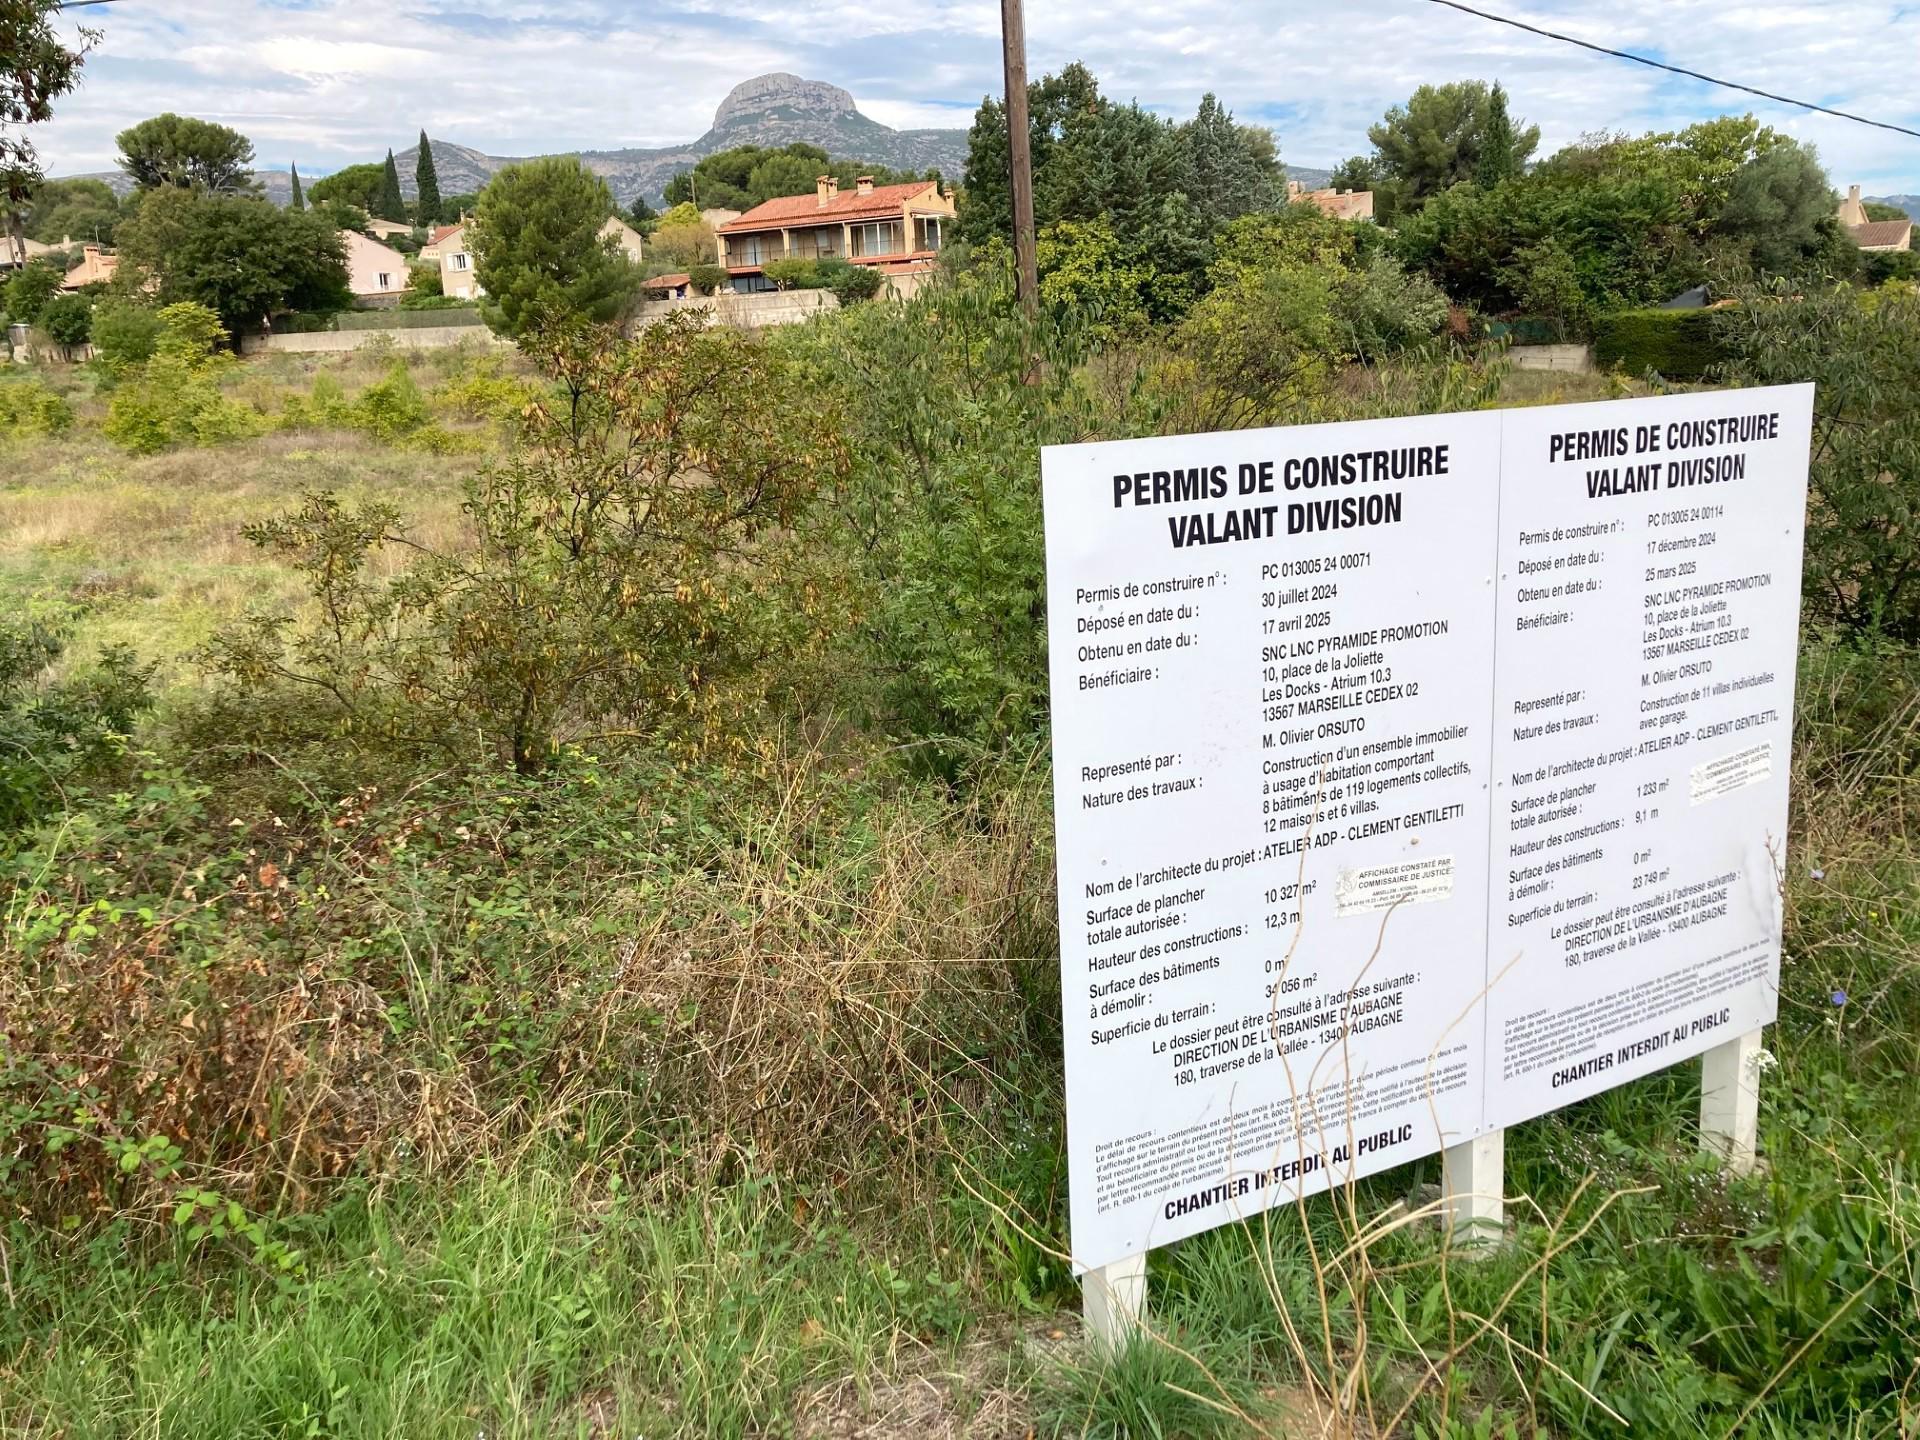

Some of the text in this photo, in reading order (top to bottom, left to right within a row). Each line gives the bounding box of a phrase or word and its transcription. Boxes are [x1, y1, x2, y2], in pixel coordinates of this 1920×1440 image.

[1548, 411, 1780, 463] PERMIS DE CONSTRUIRE
[1112, 444, 1449, 508] PERMIS DE CONSTRUIRE
[1585, 452, 1746, 499] VALANT DIVISION
[1167, 491, 1402, 549] VALANT DIVISION
[1647, 504, 1723, 527] PC 013005 24 00114
[1646, 531, 1716, 554] 17 décembre 2024
[1261, 551, 1370, 580] PC 013005 24 00071
[1644, 560, 1696, 582] 25 mars 2025
[1076, 584, 1120, 605] Permis
[1123, 581, 1139, 598] de
[1142, 574, 1204, 596] construire
[1261, 583, 1338, 609] 30 juillet 2024
[1643, 573, 1771, 608] SNC LNC PYRAMIDE PROMOTION
[1077, 603, 1192, 635] Déposé en date du
[1261, 610, 1331, 635] 17 avril 2025
[1516, 609, 1569, 631] Bénéficiaire
[1077, 631, 1191, 662] Obtenu en date du
[1261, 619, 1448, 662] SNC LNC PYRAMIDE PROMOTION
[1078, 666, 1152, 691] Bénéficiaire
[1262, 650, 1384, 683] 10, place de la Joliette
[1640, 659, 1712, 687] M. Olivier ORSUTO
[1262, 666, 1391, 703] Les Docks Atrium 10.3
[1639, 671, 1774, 713] Construction de 11 villas individuelles
[1262, 681, 1418, 722] 13567 MARSEILLE CEDEX 02
[1513, 690, 1581, 715] Representé par
[1262, 716, 1365, 749] M. Olivier ORSUTO
[1638, 709, 1688, 730] avec garage.
[1262, 750, 1333, 775] Construction
[1362, 734, 1413, 756] ensemble
[1415, 724, 1468, 746] immobilier
[1081, 753, 1175, 783] Representé par
[1082, 777, 1196, 809] Nature des travaux
[1636, 784, 1641, 798] 1
[1642, 781, 1657, 796] 233
[1313, 830, 1338, 848] ADP
[1347, 816, 1401, 841] CLEMENT
[1402, 802, 1464, 829] GENTILETTI
[1634, 807, 1659, 824] 9,1 m
[1085, 881, 1114, 899] Nom
[1117, 875, 1133, 891] de
[1204, 857, 1219, 872] du
[1221, 848, 1255, 872] projet
[1358, 867, 1399, 879] AFFICHAGE
[1438, 858, 1451, 867] PAR
[1358, 867, 1451, 889] COMMISSAIRE DE JUSTICE
[1631, 875, 1643, 890] 23
[1643, 870, 1658, 886] 749
[1085, 888, 1205, 926] Surface de plancher
[1263, 888, 1277, 904] 10
[1279, 883, 1300, 901] 327
[1086, 911, 1180, 946] totale autorisée
[1264, 911, 1299, 929] 12,3 m
[1565, 928, 1612, 951] DIRECTION
[1613, 920, 1626, 936] DE
[1088, 925, 1242, 972] Hauteur des constructions
[1089, 955, 1220, 999] Surface des bâtiments
[1089, 991, 1146, 1019] à démolir
[1090, 1002, 1209, 1045] Superficie du terrain
[1551, 1051, 1614, 1089] CHANTIER
[1616, 1029, 1671, 1065] INTERDIT
[1671, 1023, 1688, 1044] AU
[1690, 1007, 1730, 1036] PUBLIC
